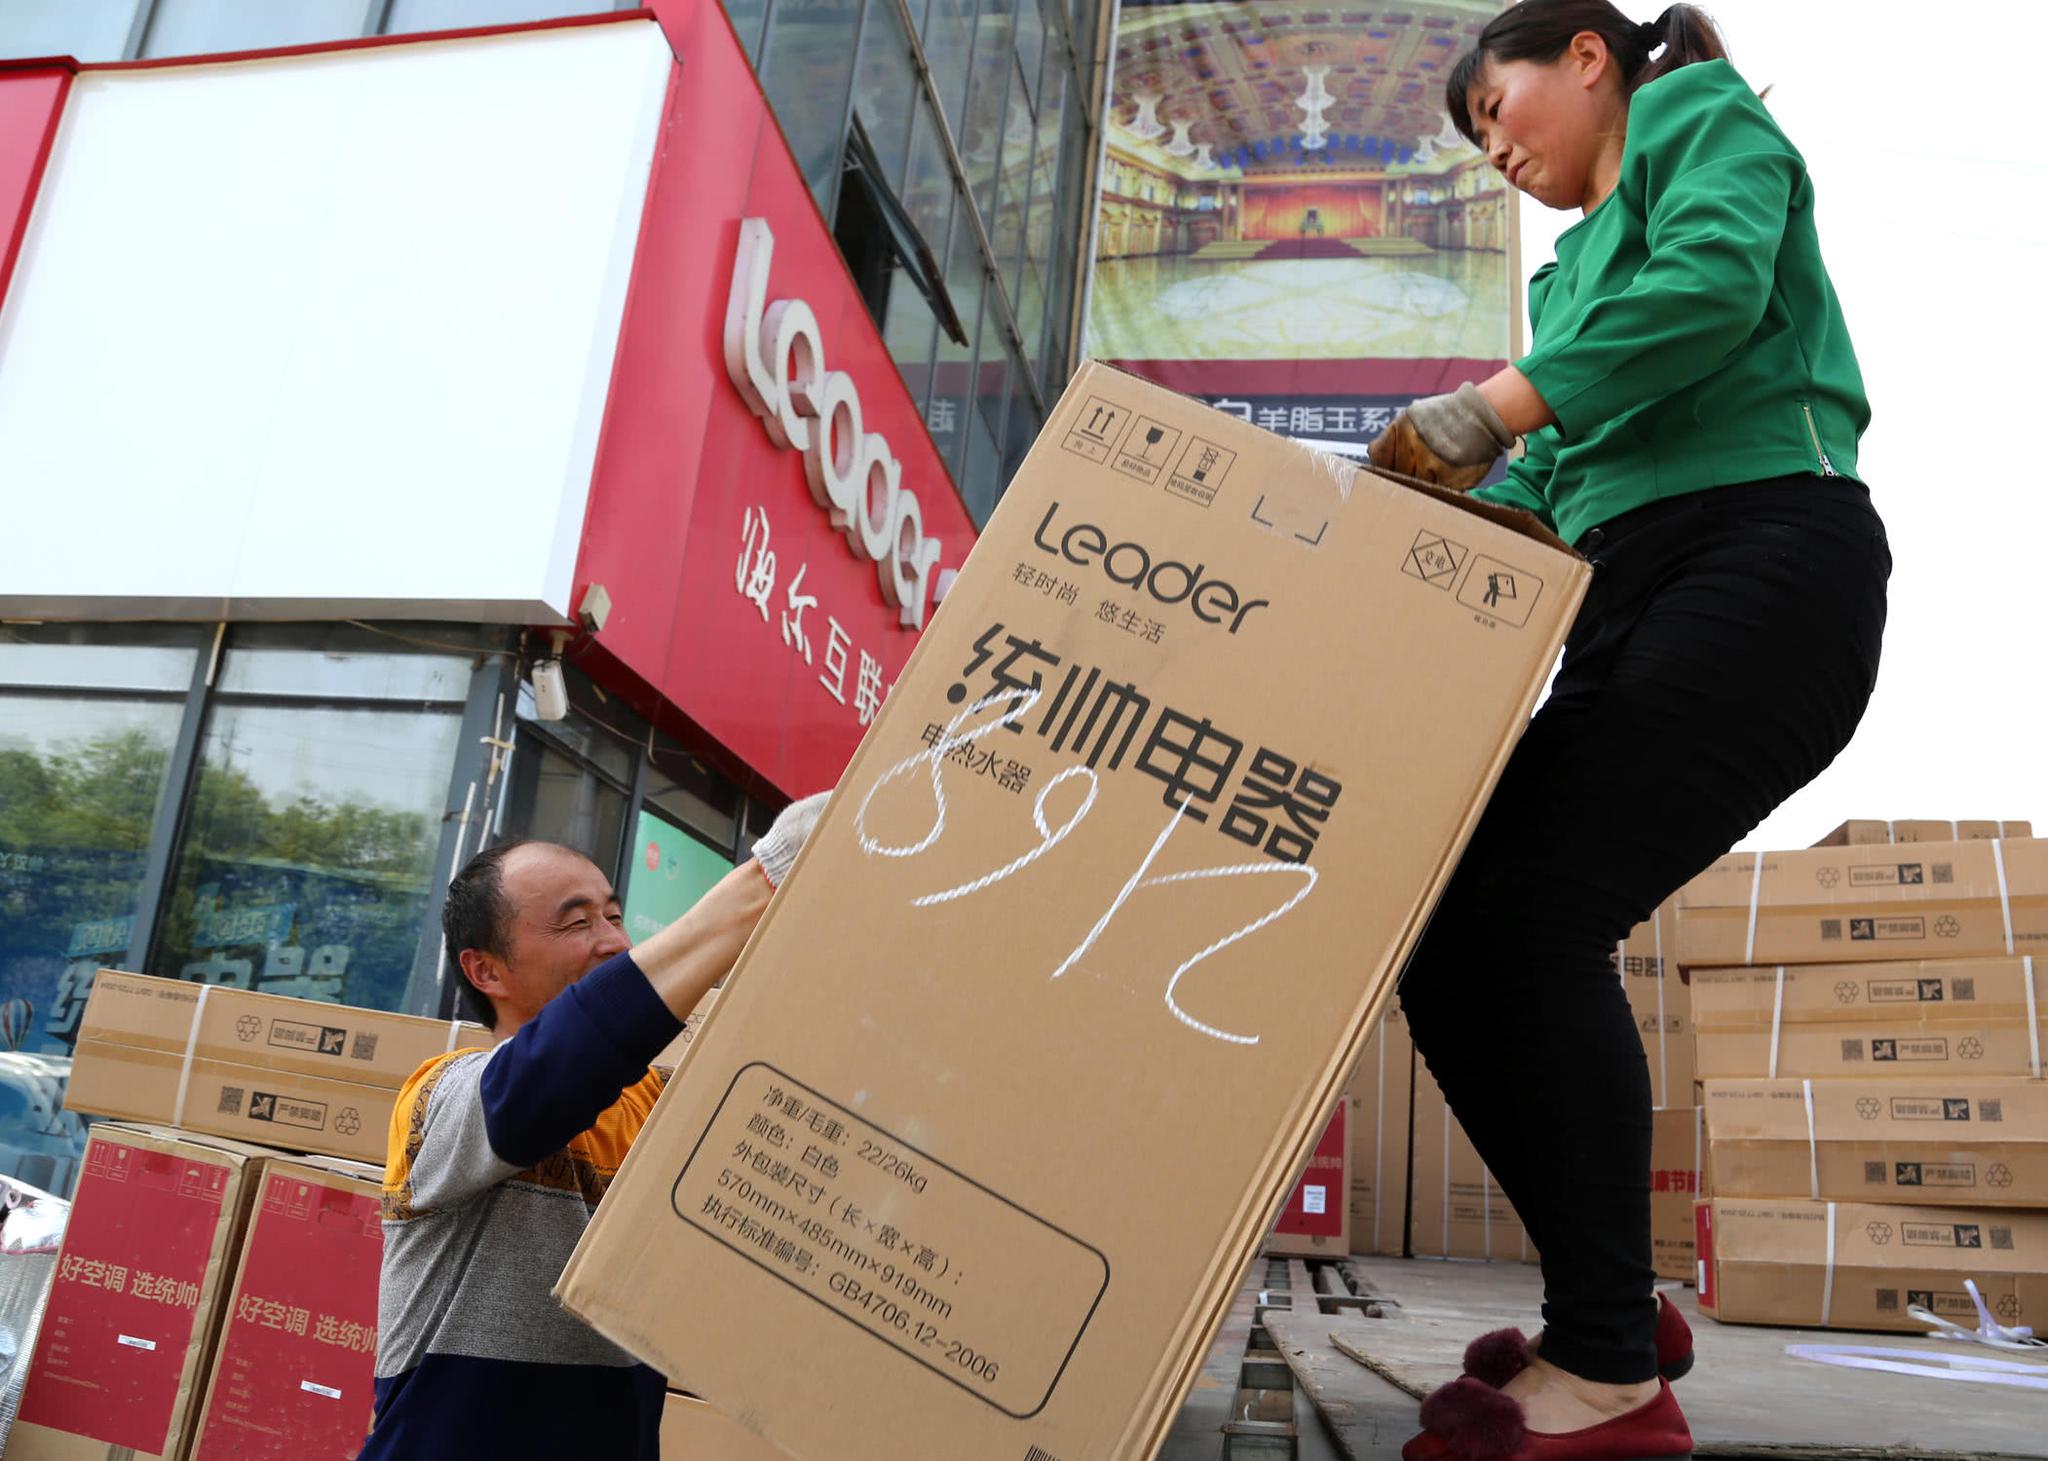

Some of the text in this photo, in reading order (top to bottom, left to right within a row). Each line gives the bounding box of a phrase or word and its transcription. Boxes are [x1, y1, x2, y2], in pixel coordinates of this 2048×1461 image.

[724, 217, 941, 632] Leader
[1256, 405, 1406, 433] 羊脂玉系
[1011, 561, 1167, 645] 轻时尚 悠生活
[1033, 501, 1269, 635] Leader
[735, 506, 895, 727] 海尔互联
[920, 722, 1032, 794] 电热水器
[946, 623, 1342, 864] 统帅电器
[58, 1252, 200, 1310] 好空调 选统帅
[235, 1293, 310, 1337] 好空调
